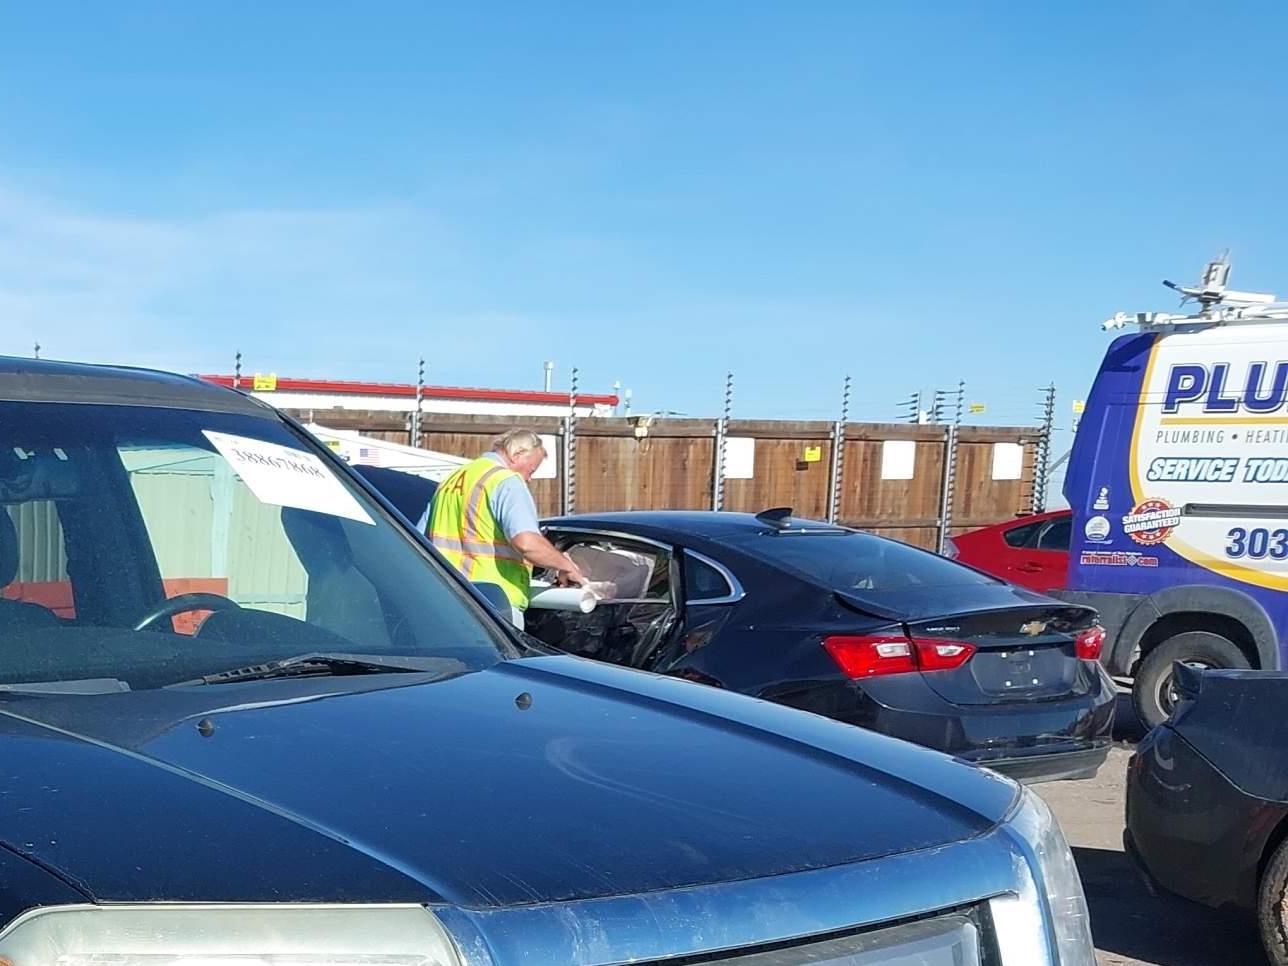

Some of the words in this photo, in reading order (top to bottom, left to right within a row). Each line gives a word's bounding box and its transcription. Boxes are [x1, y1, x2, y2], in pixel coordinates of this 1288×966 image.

[1161, 361, 1288, 414] PLU
[1156, 430, 1225, 444] PLUMBING
[1245, 429, 1288, 444] HEATI
[231, 448, 326, 479] 38867868
[1146, 457, 1240, 483] SERVICE
[1242, 457, 1288, 483] TOD
[1122, 507, 1181, 525] SATISFACTION
[1123, 517, 1180, 534] GUARANTEED
[1226, 527, 1288, 559] 303
